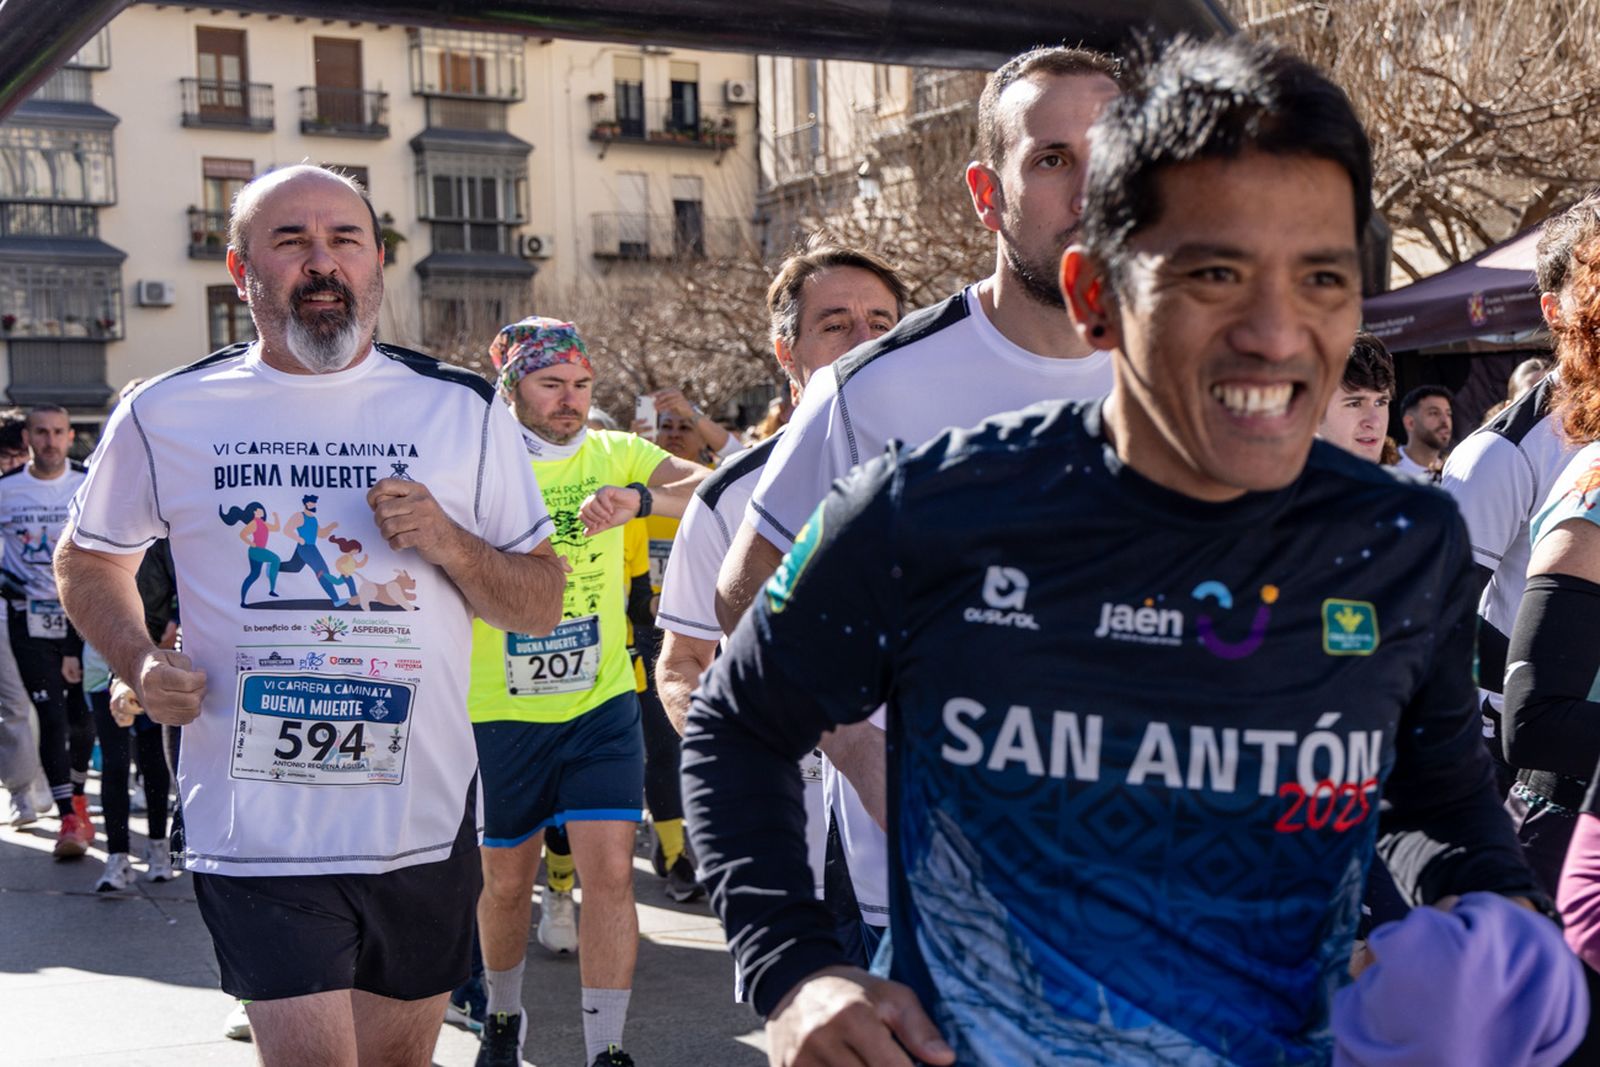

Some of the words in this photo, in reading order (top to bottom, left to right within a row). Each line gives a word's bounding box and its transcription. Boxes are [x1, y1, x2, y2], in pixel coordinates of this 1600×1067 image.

[213, 443, 229, 456] VI
[234, 441, 320, 456] CARRERA
[325, 442, 419, 458] CAMINATA
[214, 463, 282, 490] BUENA
[291, 464, 377, 489] MUERTE
[254, 624, 289, 632] beneficio
[352, 625, 411, 635] ASPERGER-TEA
[516, 641, 544, 653] BUENA
[545, 636, 578, 651] MUERTE
[528, 650, 585, 680] 207
[264, 680, 276, 689] VI
[278, 681, 331, 694] CARRERA
[334, 684, 392, 698] CAMINATA
[261, 694, 305, 715] BUENA
[310, 699, 363, 717] MUERTE
[274, 720, 366, 762] 594
[940, 697, 1103, 782] SAN
[1126, 712, 1383, 798] ANTÓN
[273, 760, 306, 769] ANTONIO
[1273, 777, 1379, 834] 2025
